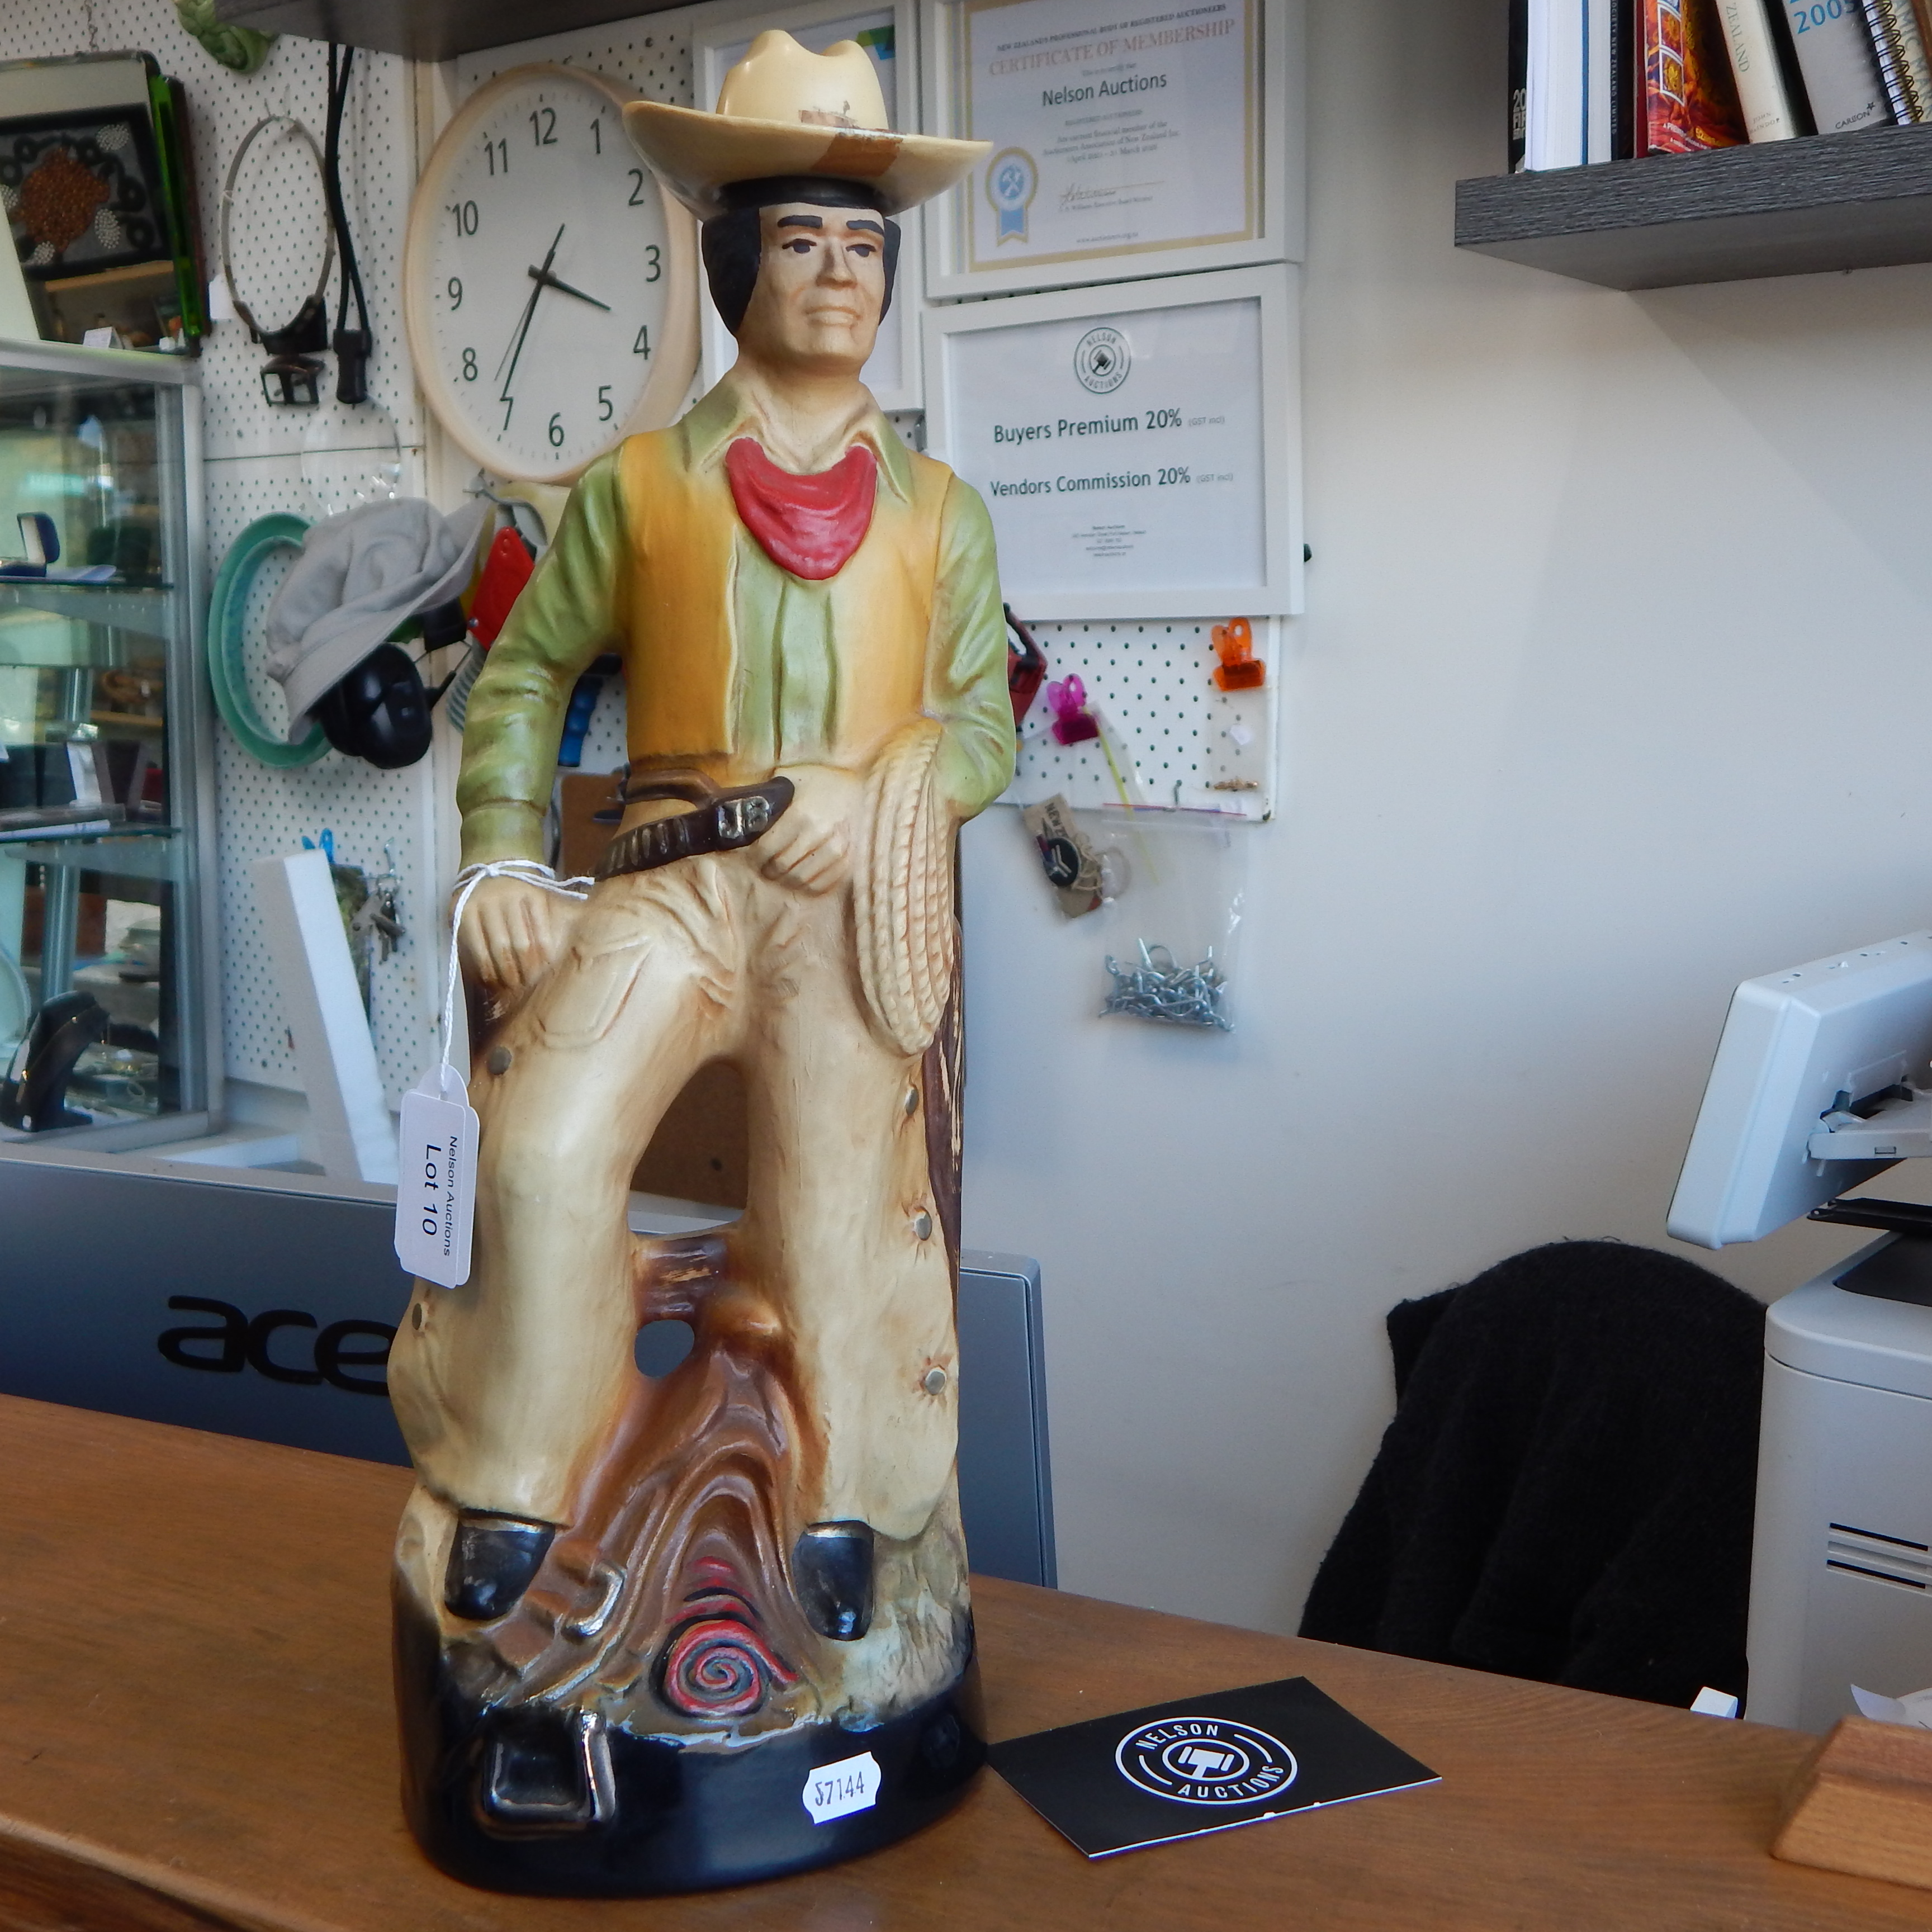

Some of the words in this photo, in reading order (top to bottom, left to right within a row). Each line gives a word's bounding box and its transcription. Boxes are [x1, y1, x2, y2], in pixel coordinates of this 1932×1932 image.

[989, 45, 1095, 76] CERTIFICATE
[1097, 39, 1118, 56] OF
[1123, 18, 1235, 51] MEMBERSHIP
[1726, 6, 1750, 72] ZEALAND
[1041, 84, 1095, 106] Nelson
[1098, 73, 1168, 97] Auctions
[529, 107, 558, 146] 12
[590, 118, 602, 154] 1
[484, 138, 508, 176] 11
[628, 168, 644, 206] 2
[452, 200, 479, 236] 10
[645, 244, 661, 282] 3
[447, 277, 463, 311] 9
[633, 325, 651, 361] 4
[462, 347, 479, 382] 8
[499, 395, 514, 430] 7
[598, 385, 614, 422] 5
[548, 412, 565, 447] 6
[993, 424, 1052, 446] Buyers
[1058, 415, 1139, 437] Premium
[1145, 408, 1183, 429] 20%
[990, 478, 1052, 497] Vendors
[1056, 471, 1152, 493] Commission
[1157, 466, 1191, 485] 20%
[424, 1144, 442, 1190] Lot
[447, 1136, 458, 1188] Nelson
[422, 1203, 439, 1236] 10
[443, 1191, 455, 1257] Auctions
[1135, 1723, 1219, 1750] NELSON
[815, 1771, 865, 1806] 57144
[1177, 1765, 1284, 1798] AUCTIONS
